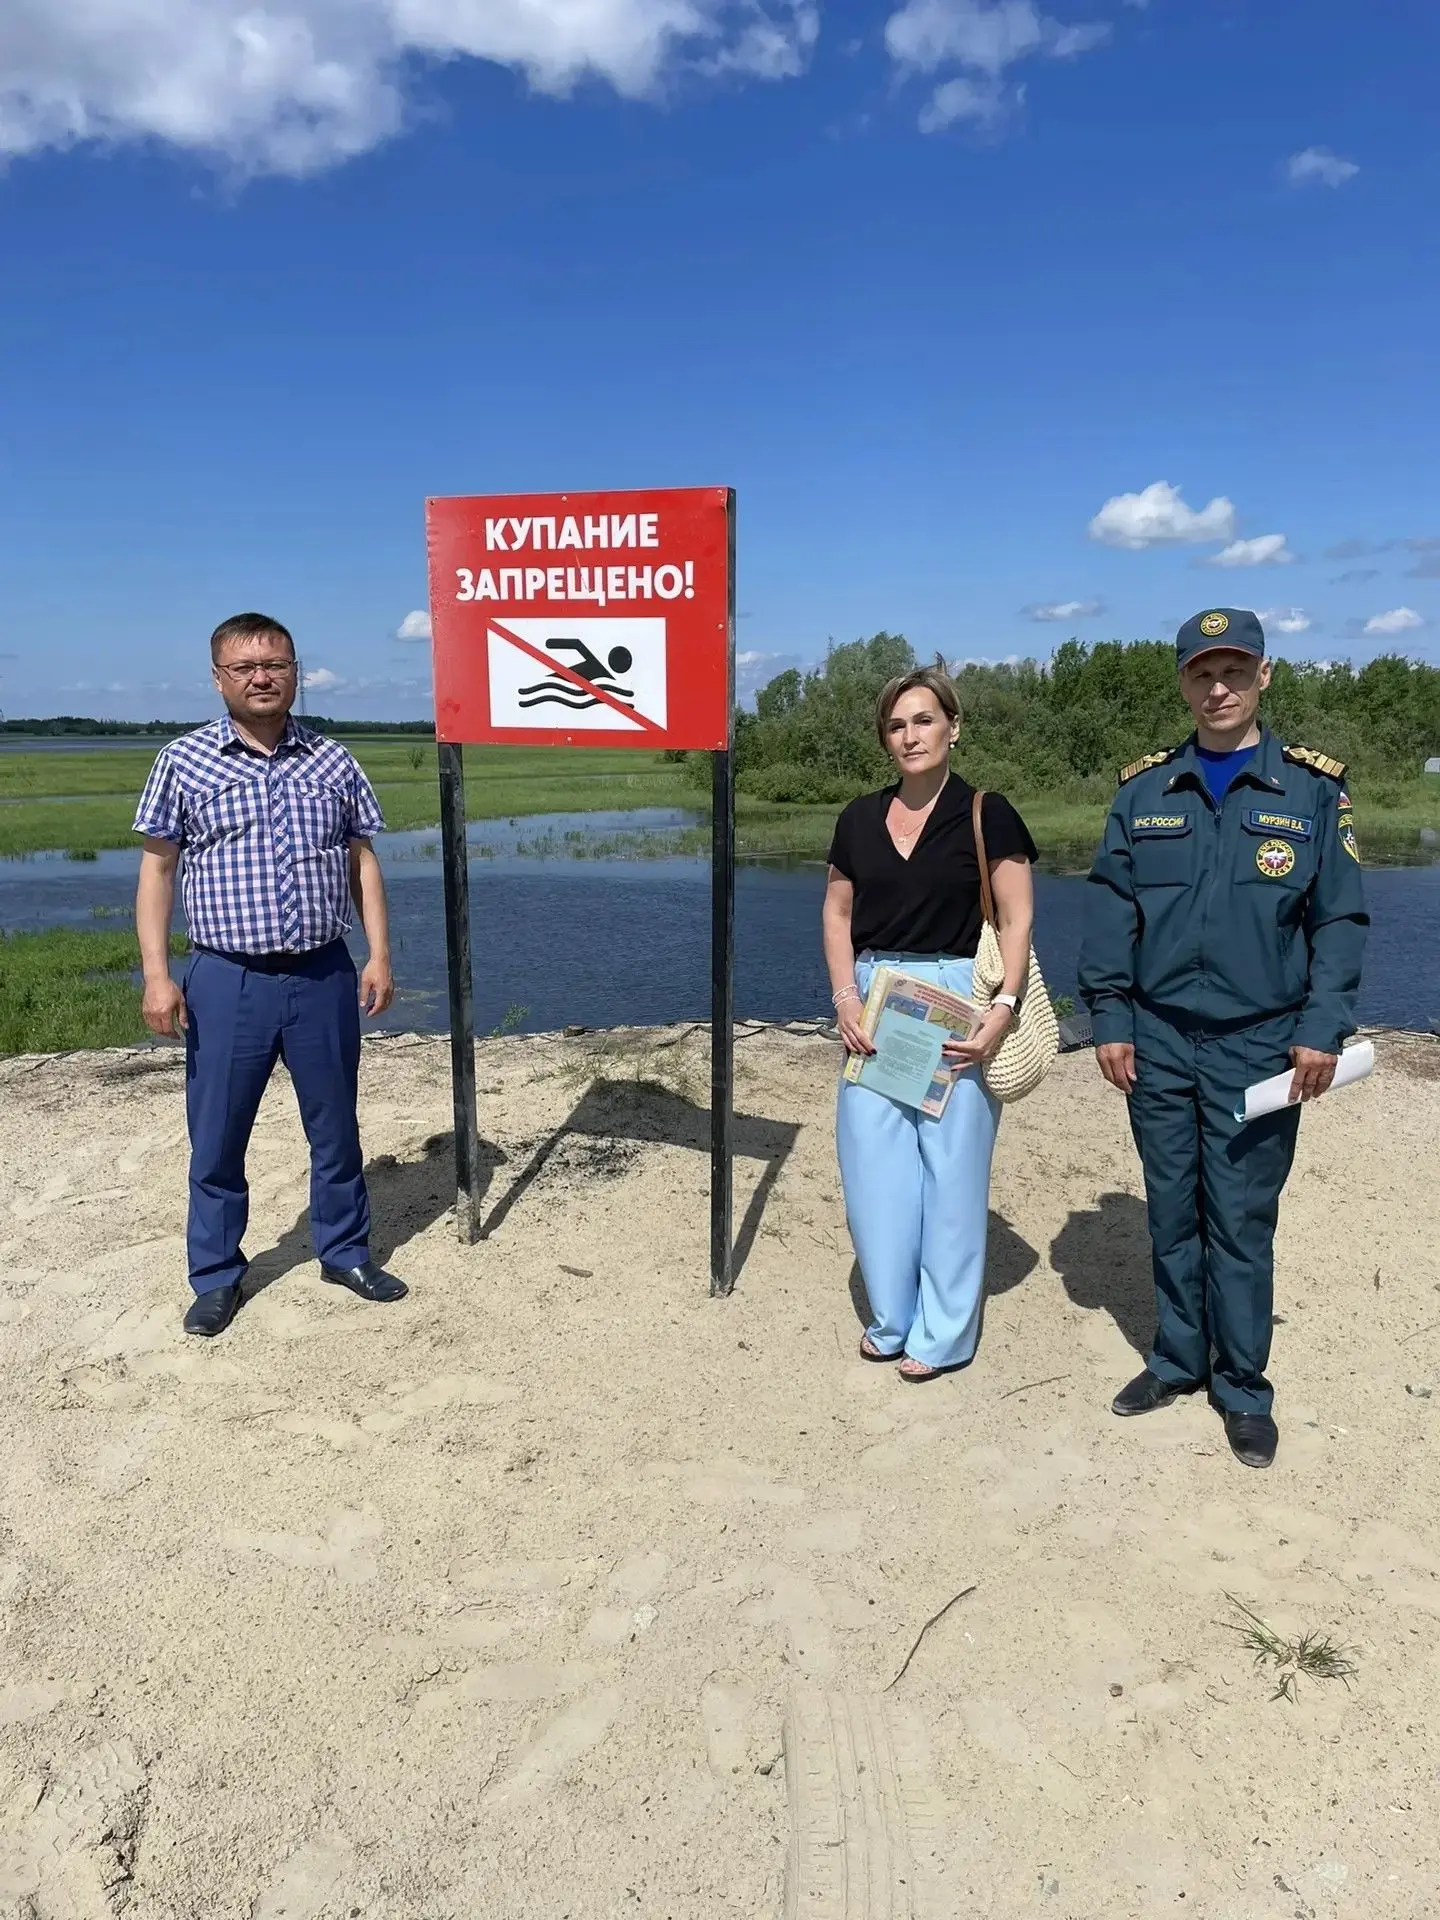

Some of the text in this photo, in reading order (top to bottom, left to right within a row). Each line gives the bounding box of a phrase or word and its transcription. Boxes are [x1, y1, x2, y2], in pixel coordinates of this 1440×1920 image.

[485, 513, 659, 551] КУПАНИЕ
[455, 561, 695, 607] ЗАПРЕЩЕНО!
[1135, 817, 1185, 827] МЧС РОССИИ
[1259, 814, 1290, 827] МУРЗИН
